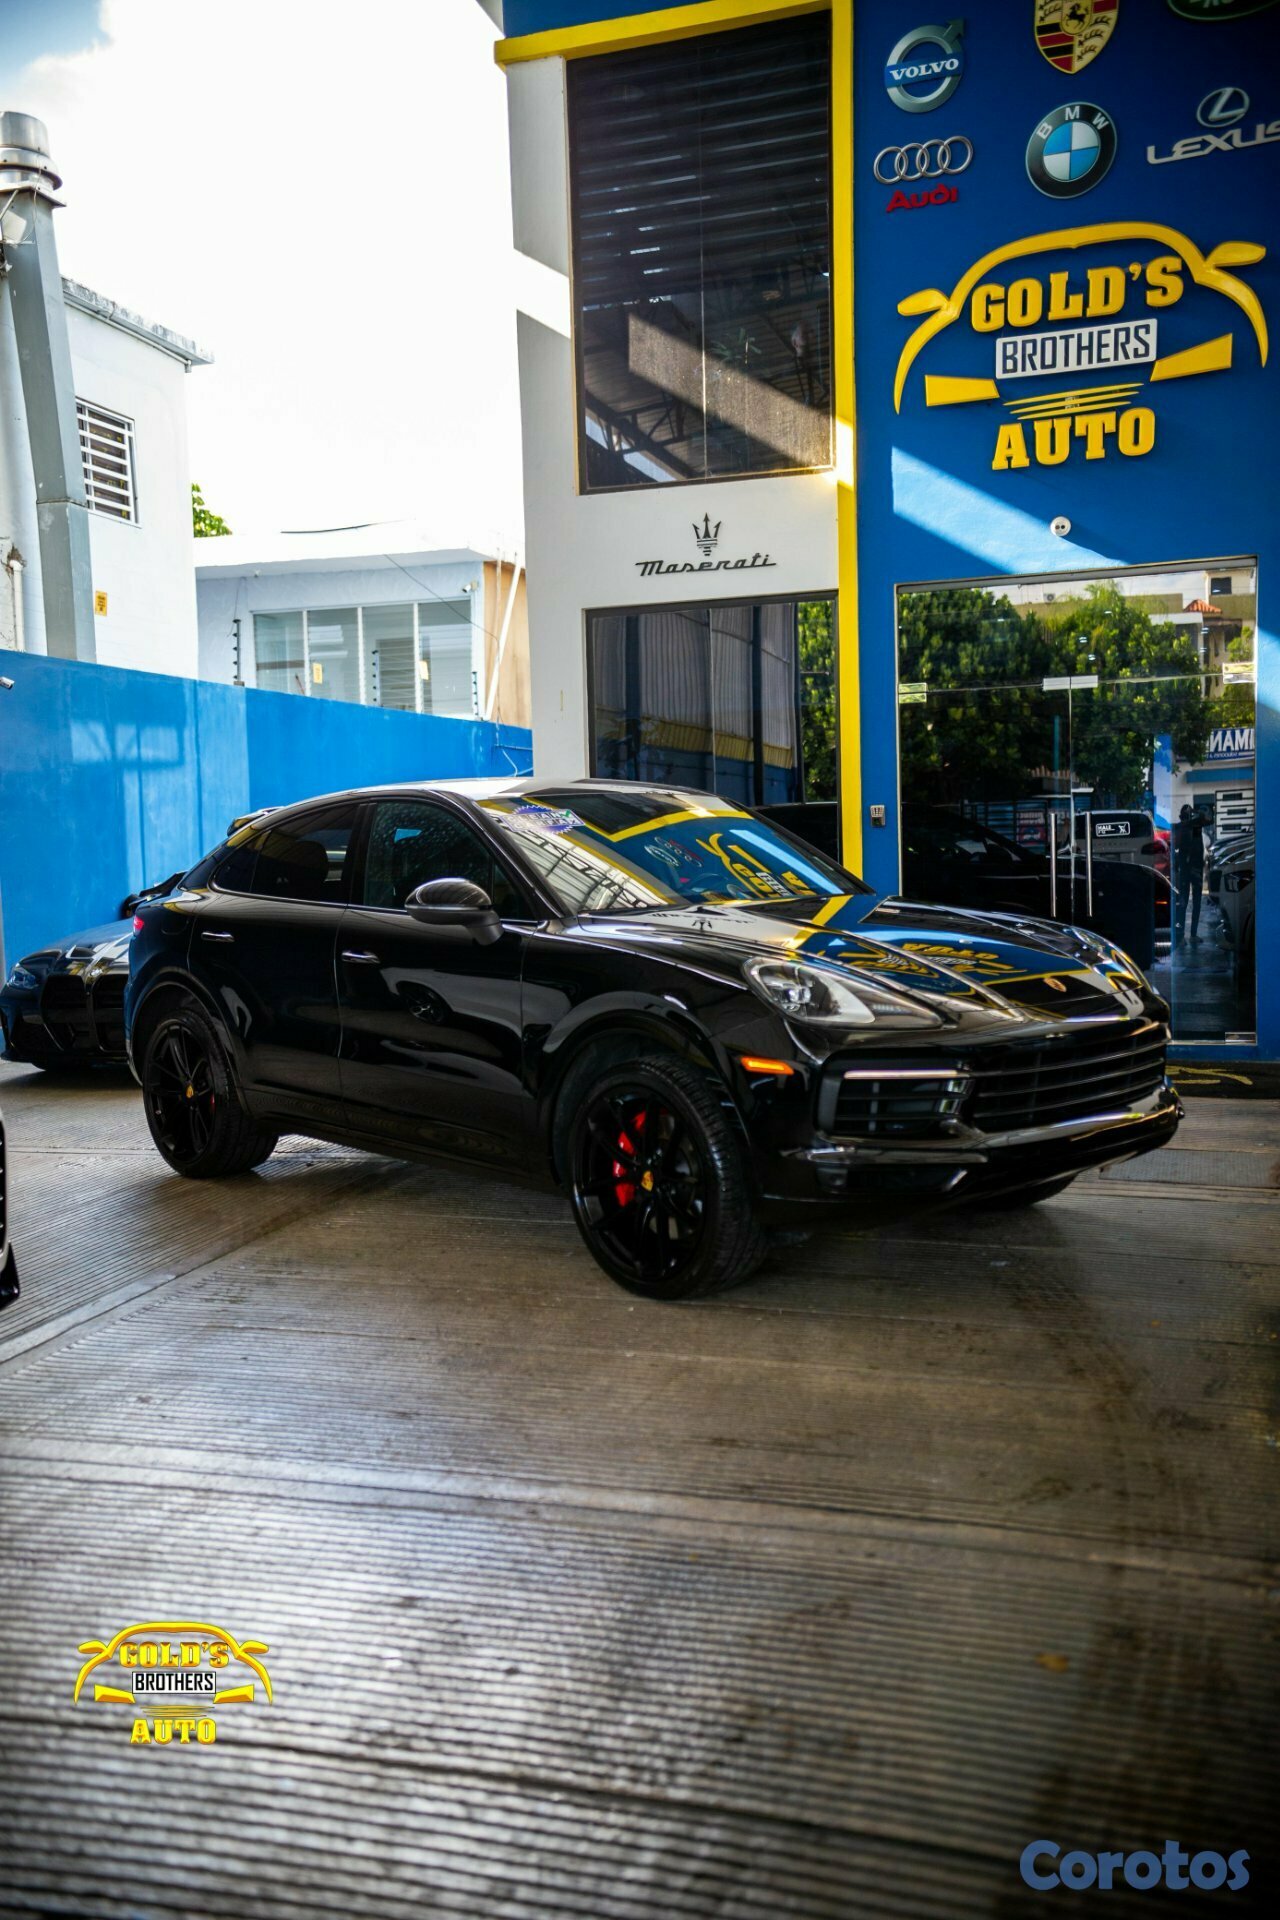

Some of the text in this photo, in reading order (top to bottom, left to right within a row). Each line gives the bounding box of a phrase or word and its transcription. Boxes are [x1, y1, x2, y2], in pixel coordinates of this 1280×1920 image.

[889, 58, 960, 81] VOLVO
[1036, 105, 1110, 140] BMW
[885, 182, 959, 214] Audi
[971, 255, 1184, 333] GOLD'S
[1001, 322, 1152, 375] BROTHERS
[991, 407, 1156, 471] AUTO
[635, 552, 777, 577] Maserati
